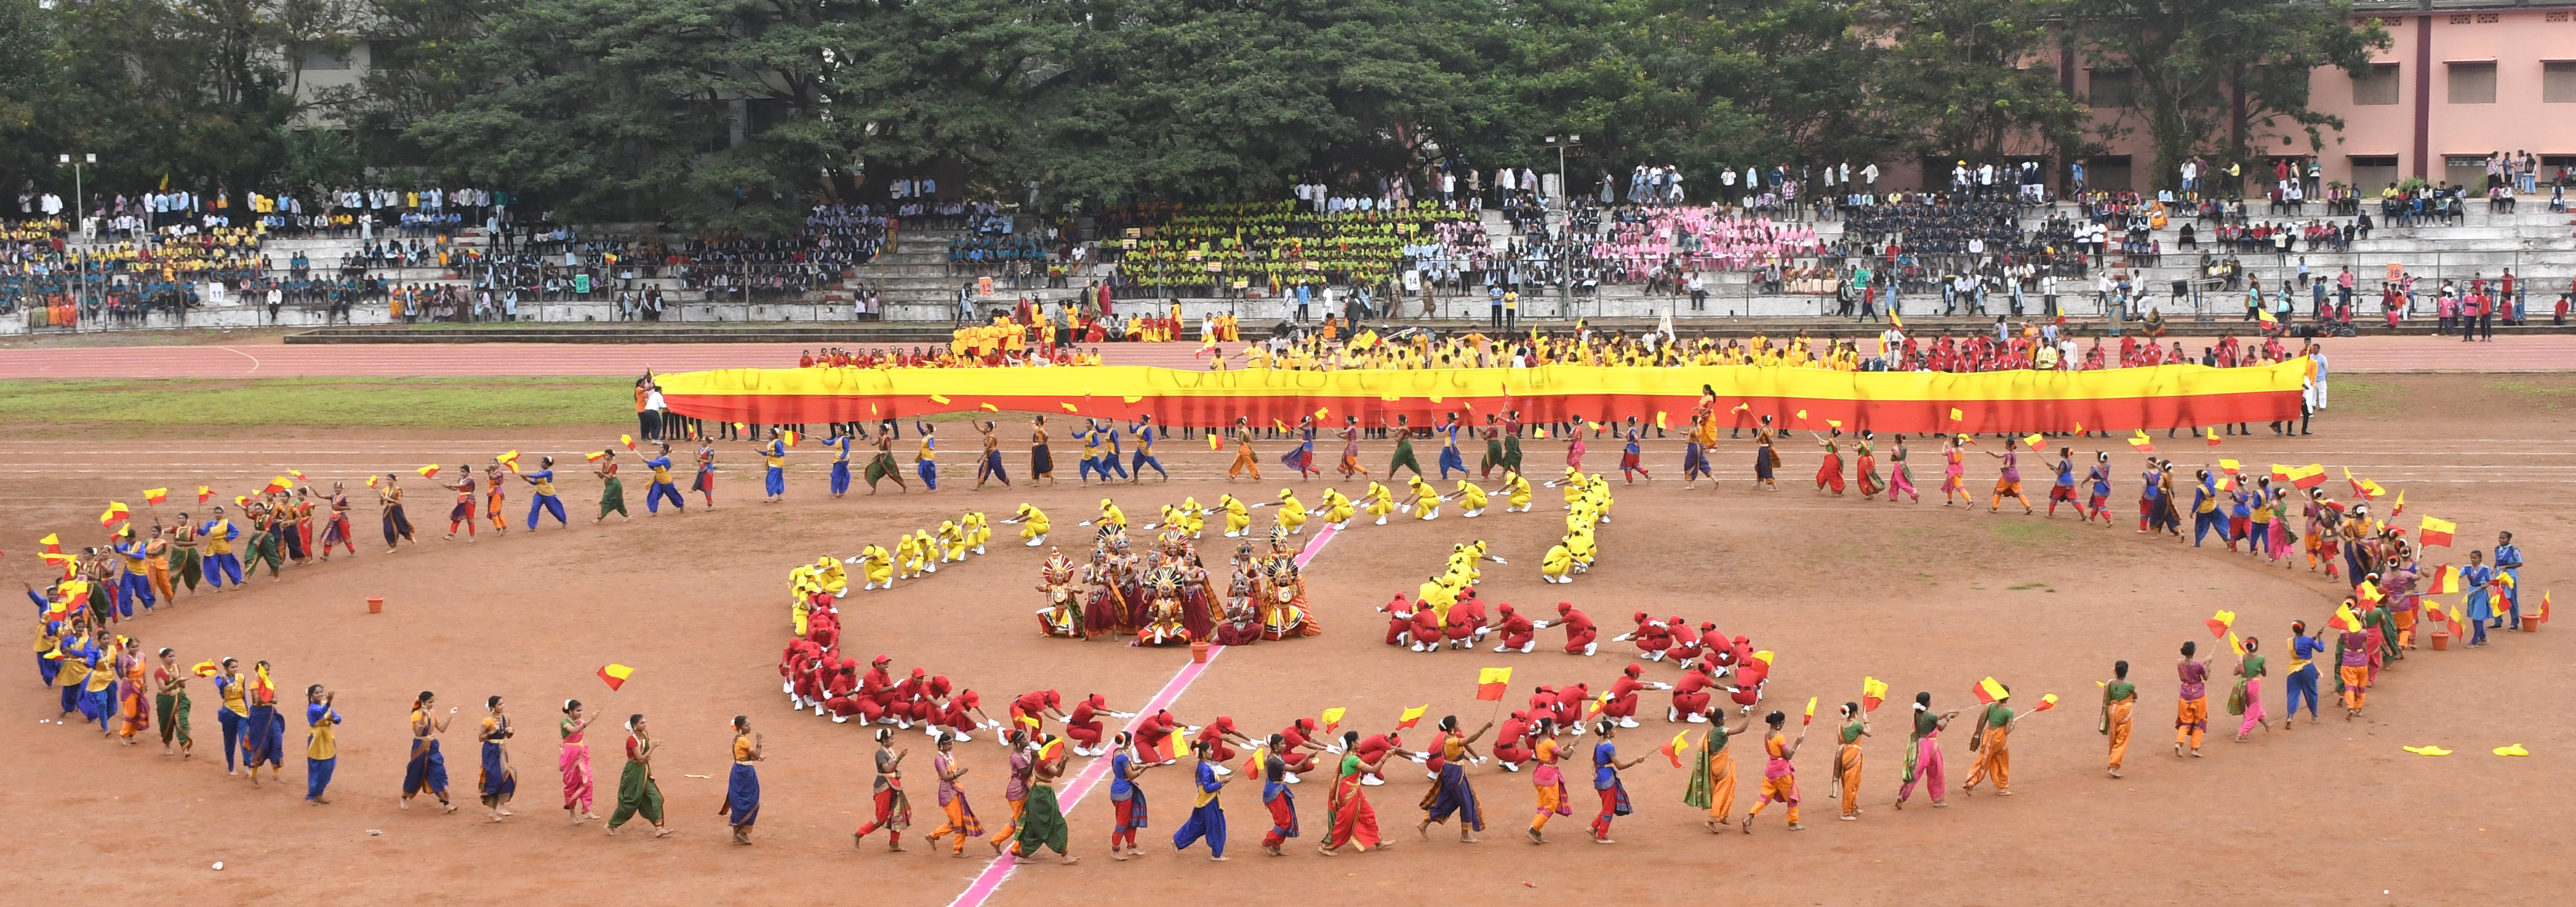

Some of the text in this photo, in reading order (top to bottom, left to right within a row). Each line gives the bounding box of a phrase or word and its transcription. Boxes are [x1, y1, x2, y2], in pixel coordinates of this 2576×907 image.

[2390, 270, 2400, 278] 16
[1409, 277, 1417, 285] 14
[1858, 276, 1866, 284] 15
